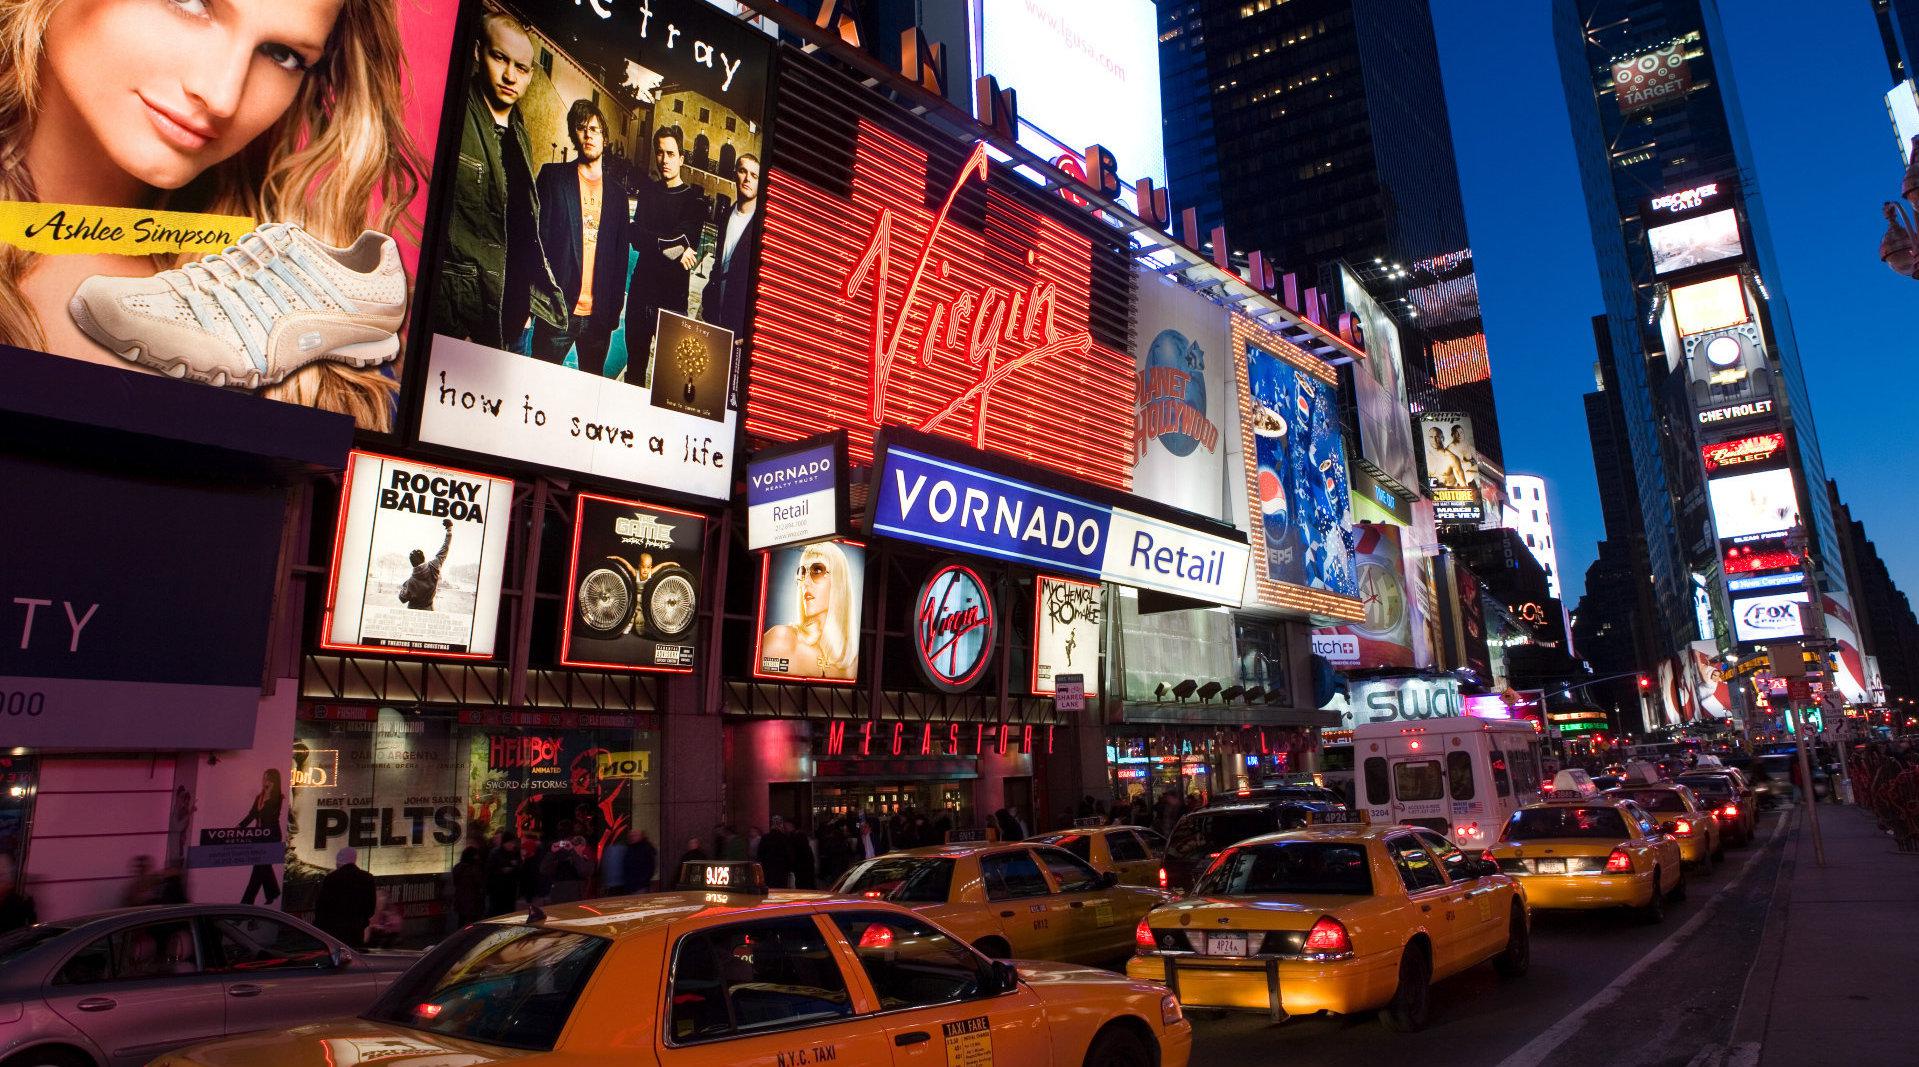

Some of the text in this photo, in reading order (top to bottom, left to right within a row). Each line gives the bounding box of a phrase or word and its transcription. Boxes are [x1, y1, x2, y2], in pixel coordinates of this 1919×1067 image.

[1624, 78, 1685, 105] TARGET
[1652, 183, 1718, 210] DISCOVER
[1670, 197, 1704, 212] CARD
[25, 210, 235, 250] Ashlee Simpson
[846, 139, 1092, 450] Virgin
[1135, 366, 1192, 408] PLANET
[439, 371, 724, 468] how to save a life
[1698, 400, 1773, 424] CHEVROLET
[1133, 401, 1219, 469] HOLLYWOOD
[1719, 452, 1772, 466] SELECT
[390, 469, 482, 502] ROCKY
[752, 458, 831, 489] VORNADO
[765, 475, 819, 492] REALTY TRUST
[379, 488, 483, 524] BALBOA
[772, 498, 810, 522] Retail
[895, 468, 1225, 586] VORNADO Retail
[922, 571, 990, 676] Virgin
[1754, 604, 1794, 619] FOX
[531, 766, 561, 774] ANIMATED
[486, 778, 568, 789] SWORD of STORMS
[317, 797, 373, 806] MEAT LOAF
[404, 796, 430, 805] JOHN
[313, 805, 464, 850] PELTS
[1325, 812, 1347, 823] 4P24
[208, 828, 271, 839] VORNADO
[706, 866, 730, 885] 9J25
[946, 1017, 987, 1037] TAXI FARE
[812, 1044, 836, 1062] TAXI
